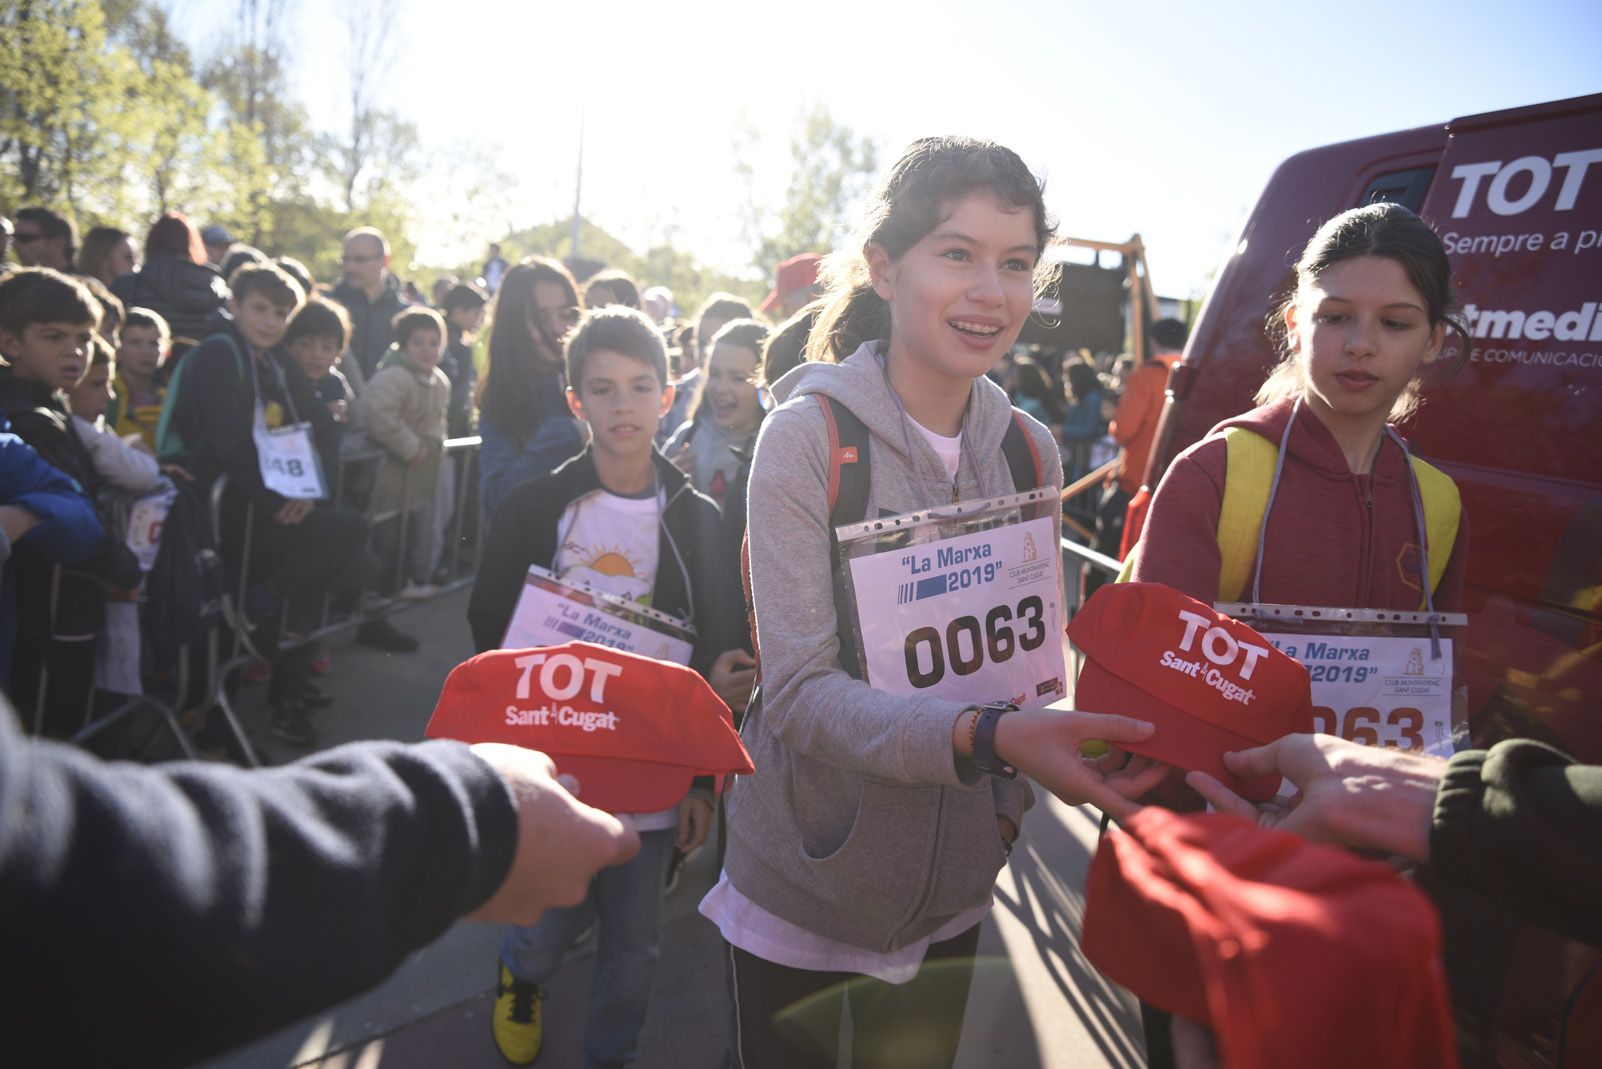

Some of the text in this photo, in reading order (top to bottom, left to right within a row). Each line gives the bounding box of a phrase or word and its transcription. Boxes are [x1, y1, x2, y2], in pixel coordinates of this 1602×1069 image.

[1451, 149, 1602, 219] TOT
[1443, 232, 1543, 257] Sempre
[1550, 232, 1568, 250] a
[1445, 302, 1602, 342] tmedi
[937, 544, 992, 568] Marxa
[948, 560, 1002, 592] 2019”
[583, 613, 632, 640] Marxa
[904, 595, 1046, 689] 0063
[1179, 609, 1269, 680] TOT
[1304, 642, 1370, 661] Marxa
[514, 653, 623, 704] TOT
[1160, 650, 1254, 705] Sant Cugat
[1311, 665, 1378, 683] 2019”
[505, 705, 617, 731] Sant Cugat
